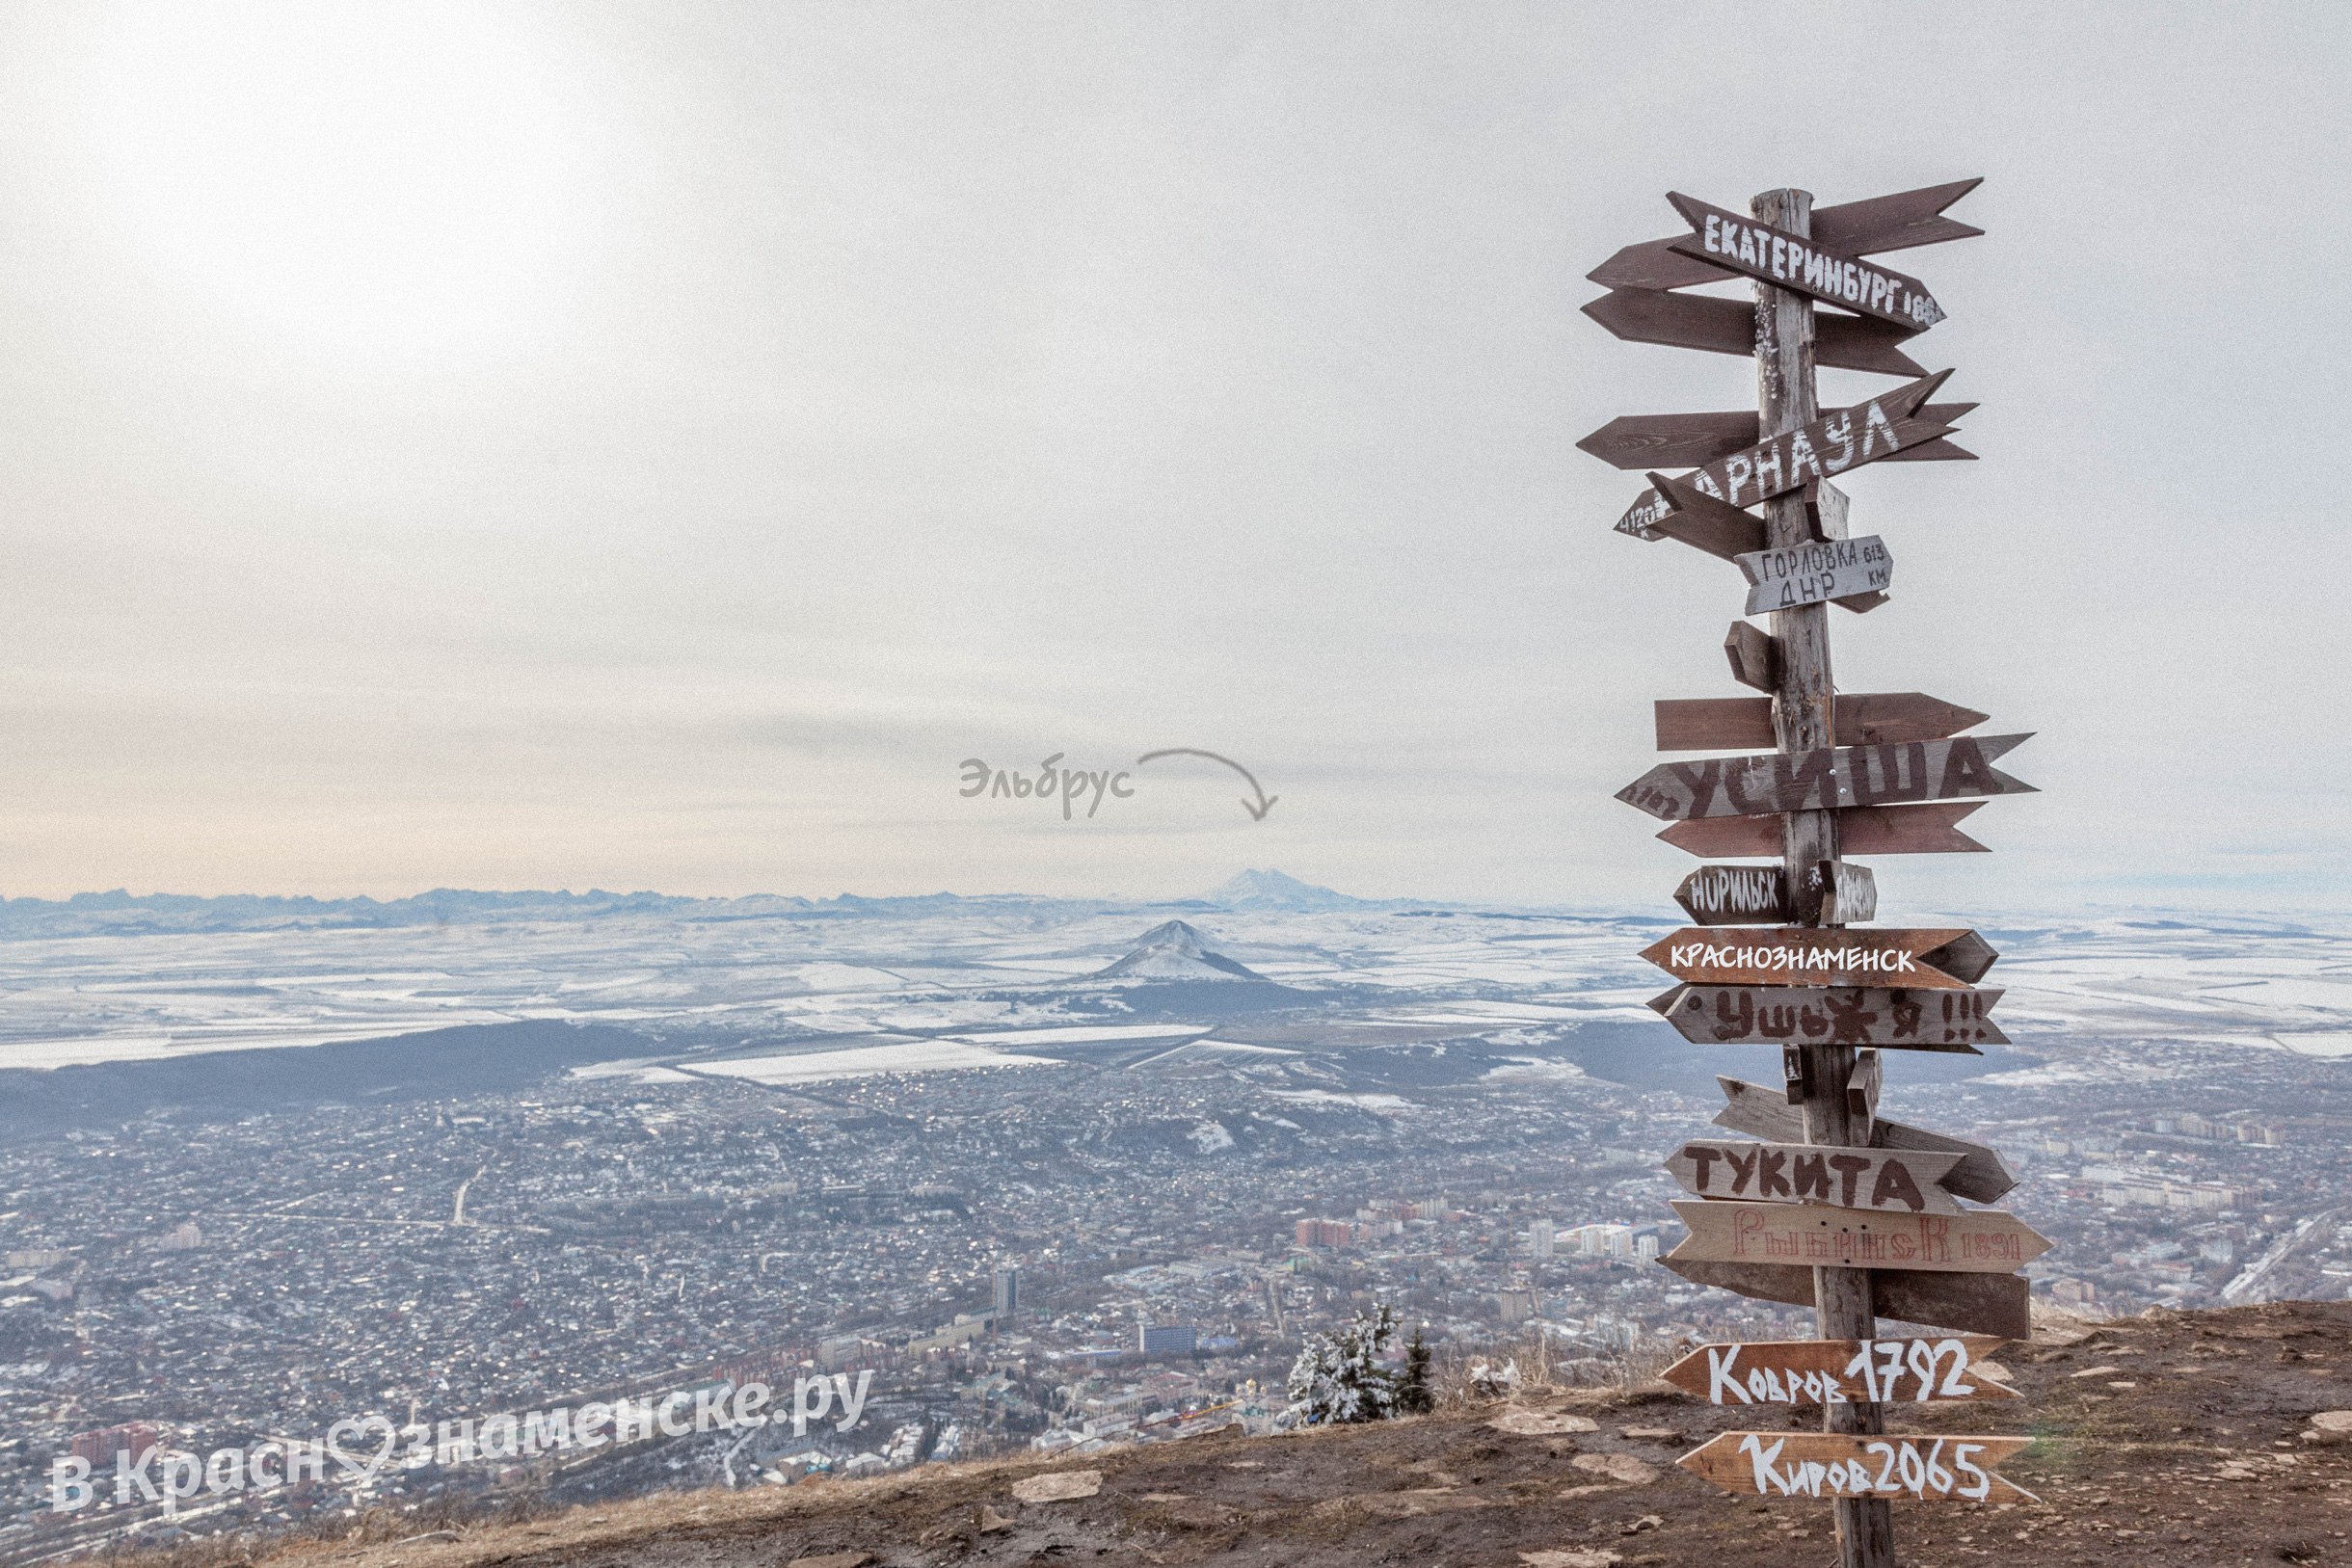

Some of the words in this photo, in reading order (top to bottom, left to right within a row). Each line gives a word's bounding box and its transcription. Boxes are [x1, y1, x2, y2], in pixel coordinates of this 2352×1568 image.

[1704, 214, 1903, 314] ЕКАТЕРИНБУРГ
[1761, 541, 1858, 582] ГОРЛОВКА
[1863, 544, 1884, 563] 613
[1779, 570, 1835, 607] ДНР
[1667, 735, 2005, 819] УСИША
[1690, 868, 1779, 914] НОРИЛЬСК
[1670, 943, 1916, 972] КРАСНОЗНАМЕНСК
[1683, 1146, 1926, 1212] ТУКИТА
[1960, 1232, 2021, 1261] 1891
[1845, 1339, 1976, 1402] 1792
[1867, 1439, 1991, 1502] 2065
